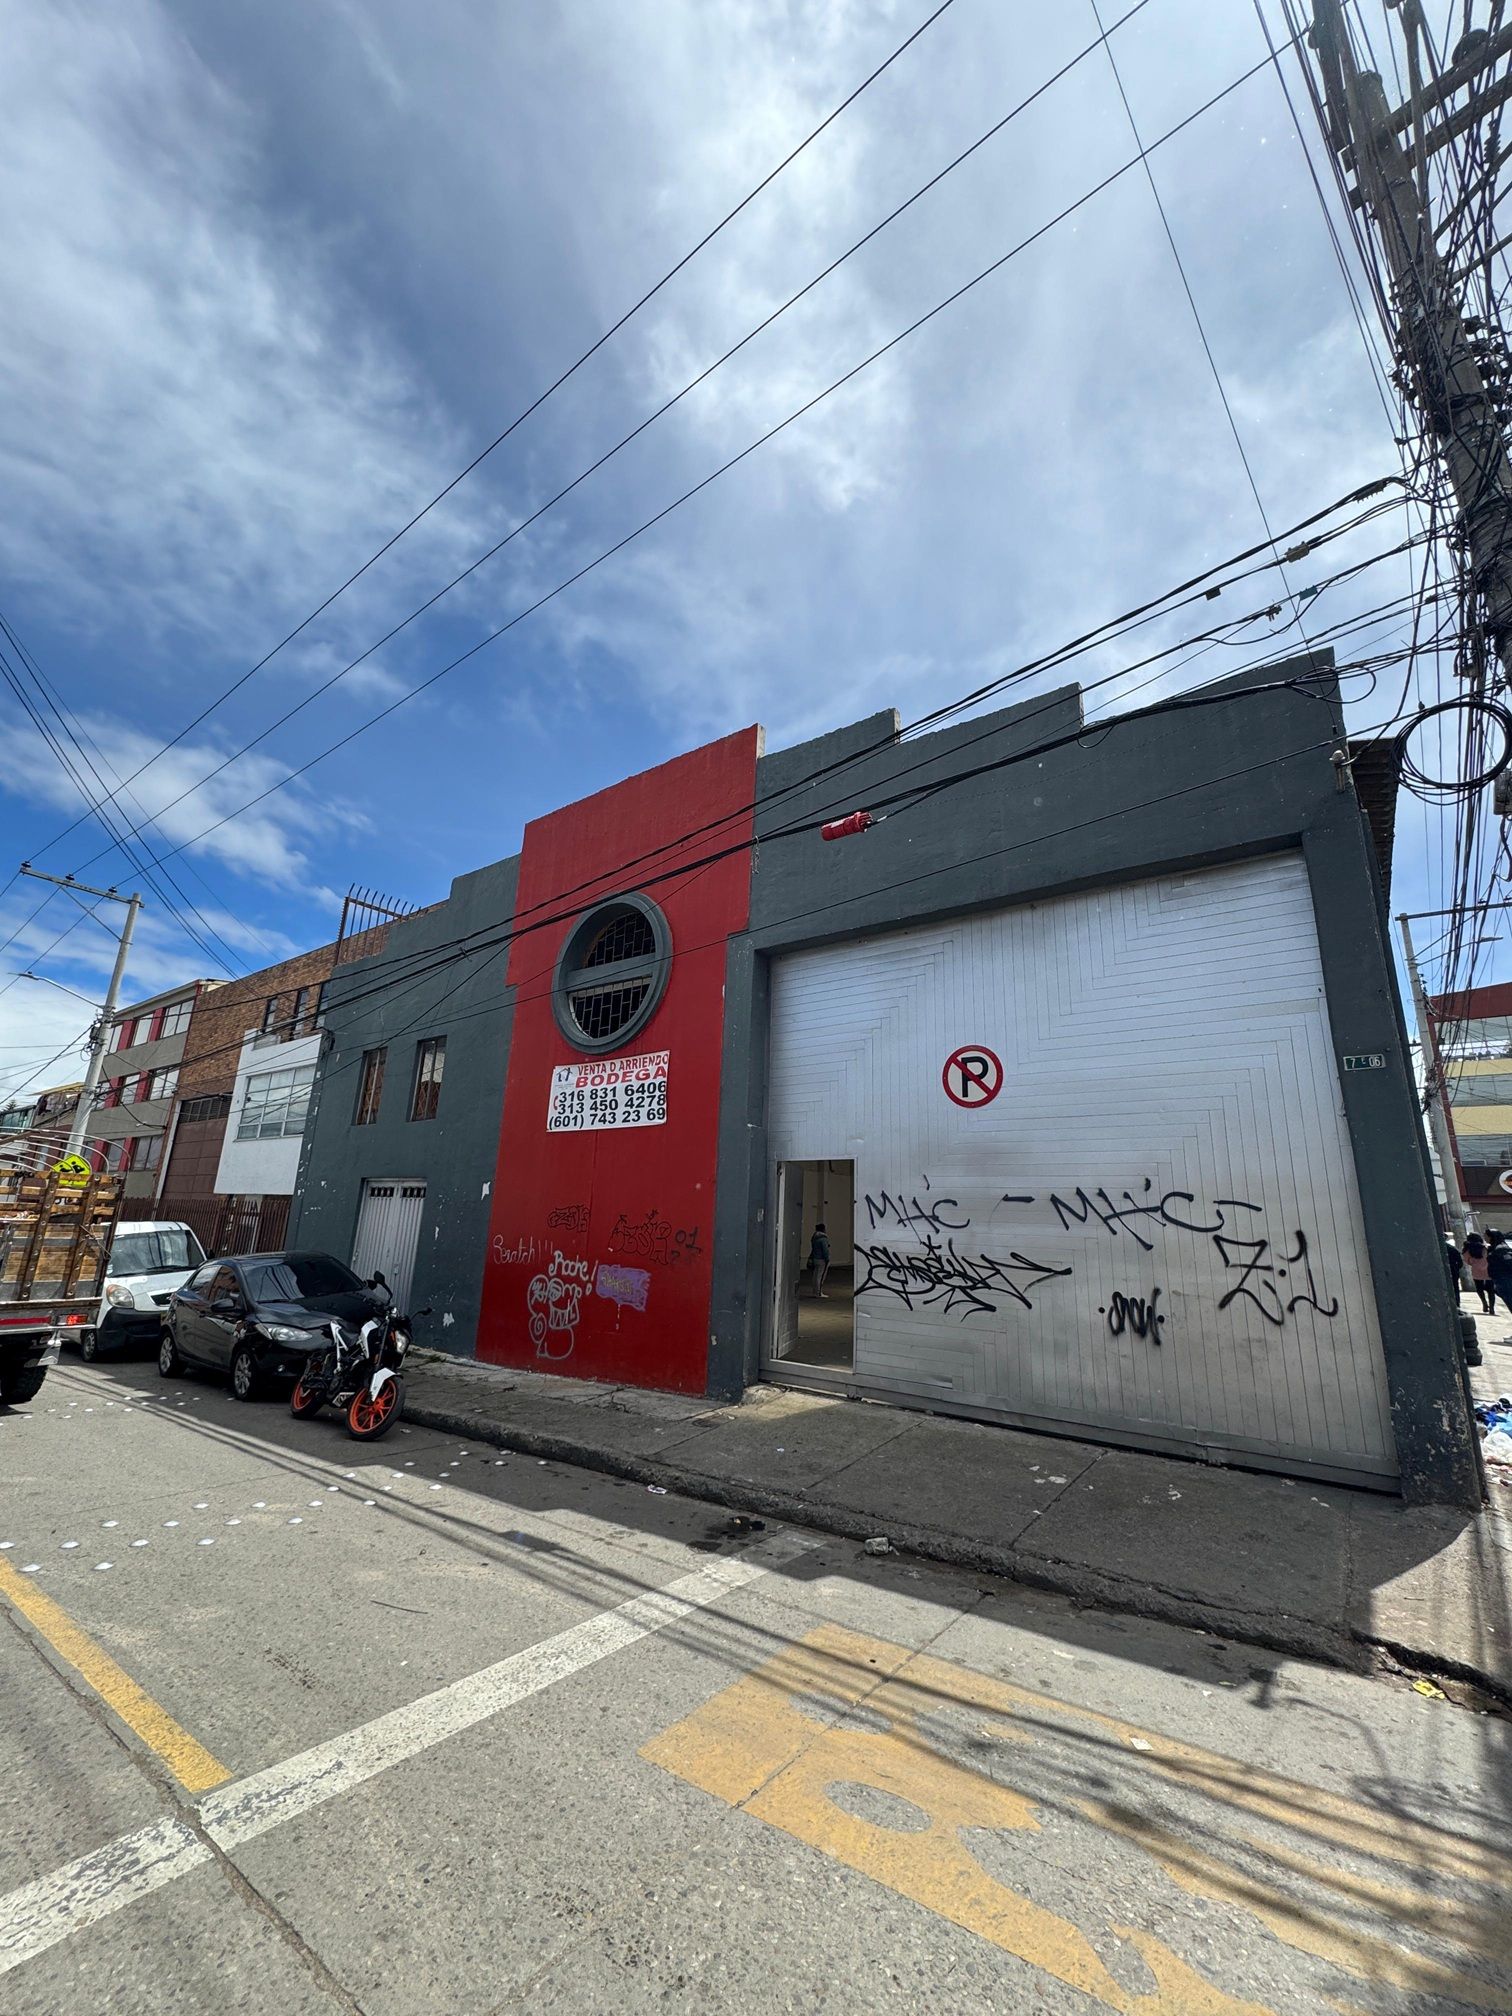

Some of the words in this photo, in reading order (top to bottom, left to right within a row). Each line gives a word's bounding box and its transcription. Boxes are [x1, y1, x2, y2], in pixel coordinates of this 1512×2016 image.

[578, 1062, 607, 1076] VENTA
[619, 1053, 669, 1072] ARRIENDO
[575, 1066, 667, 1088] BODEGA
[559, 1090, 585, 1103] 316
[590, 1086, 617, 1100] 831
[624, 1081, 666, 1097] 6406
[558, 1103, 584, 1115] 313
[589, 1099, 618, 1112] 450
[624, 1093, 666, 1110] 4278
[549, 1115, 584, 1131] (601)
[590, 1111, 617, 1125] 743
[621, 1109, 641, 1123] 23
[646, 1107, 666, 1121] 69
